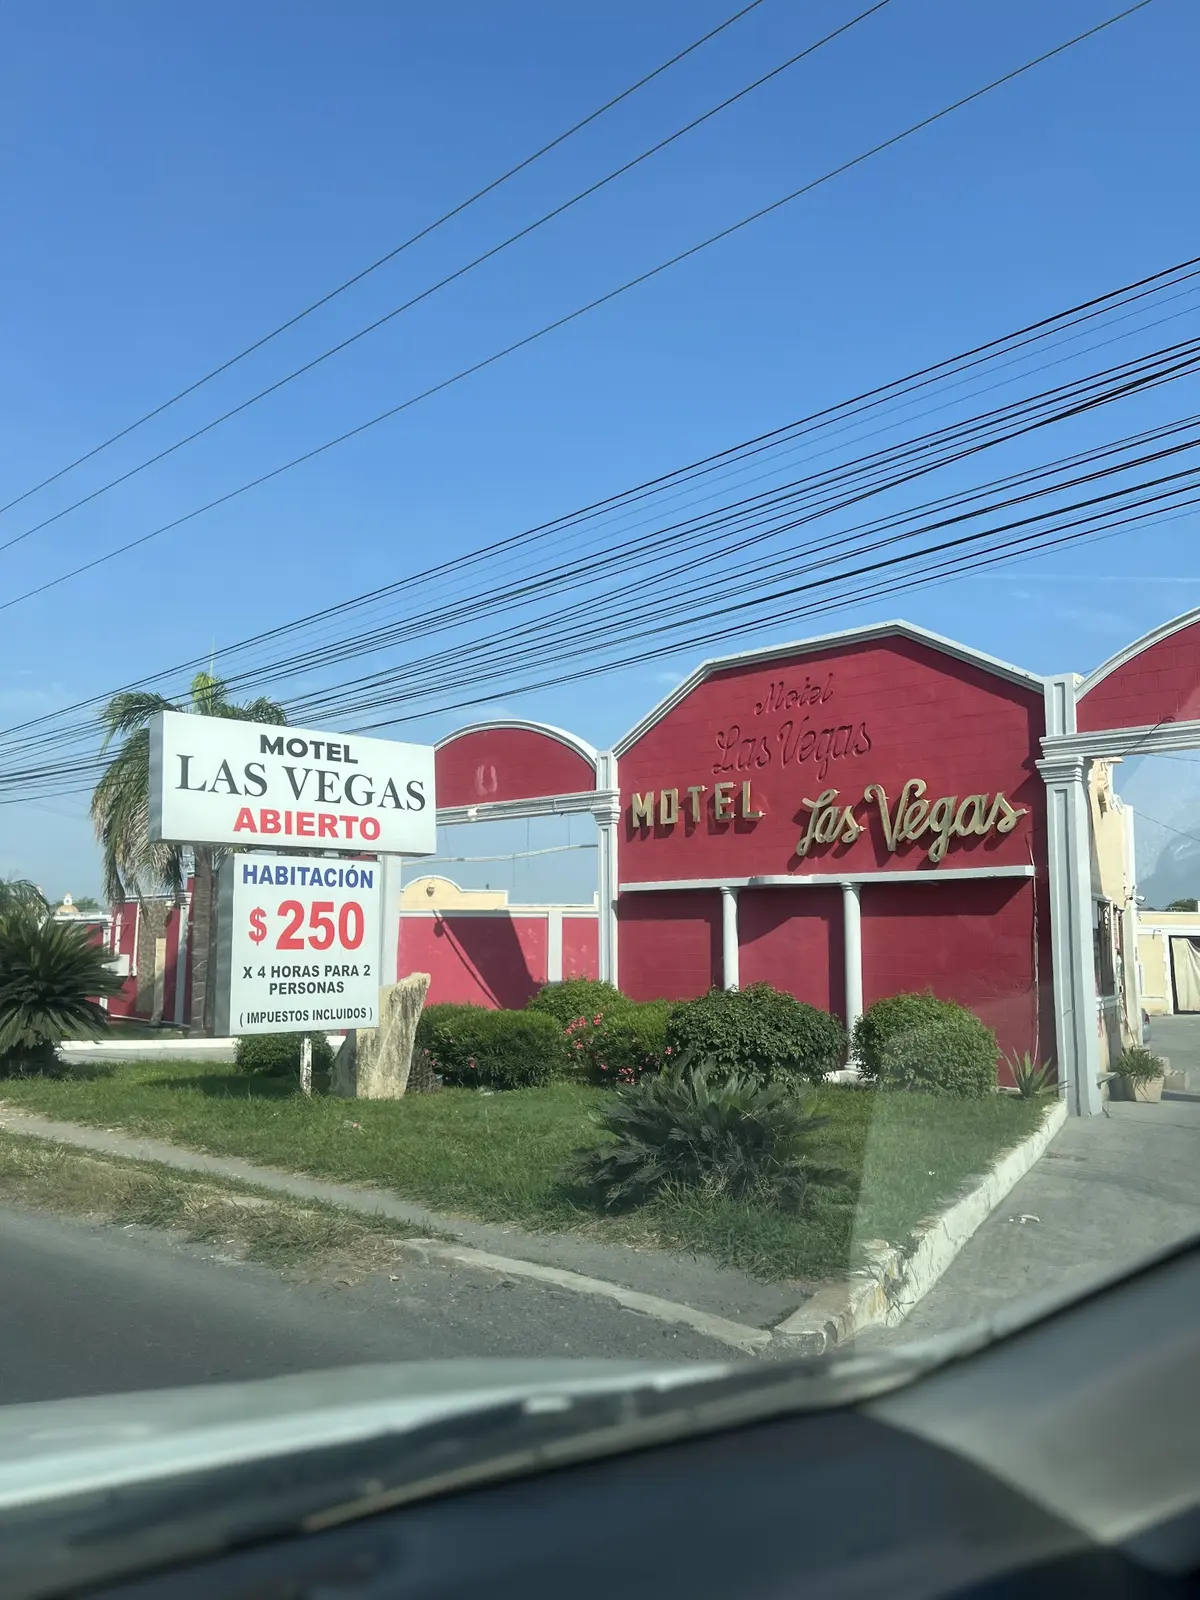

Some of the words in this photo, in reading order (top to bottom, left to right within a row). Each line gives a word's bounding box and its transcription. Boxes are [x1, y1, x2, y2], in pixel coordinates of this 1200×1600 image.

[754, 673, 834, 716] Motel
[260, 734, 359, 764] MOTEL
[712, 724, 772, 776] Las
[776, 716, 873, 782] Vegas
[175, 754, 268, 797] LAS
[282, 765, 426, 812] VEGAS
[233, 807, 381, 841] ABIERTO
[631, 780, 765, 828] MOTEL
[796, 788, 866, 857] Las
[864, 778, 1030, 863] Vegas
[242, 864, 373, 889] HABITACIÓN
[257, 966, 266, 979] 4
[270, 965, 320, 978] HORAS
[324, 965, 360, 978] PARA
[363, 964, 371, 976] 2
[269, 981, 345, 995] PERSONAS
